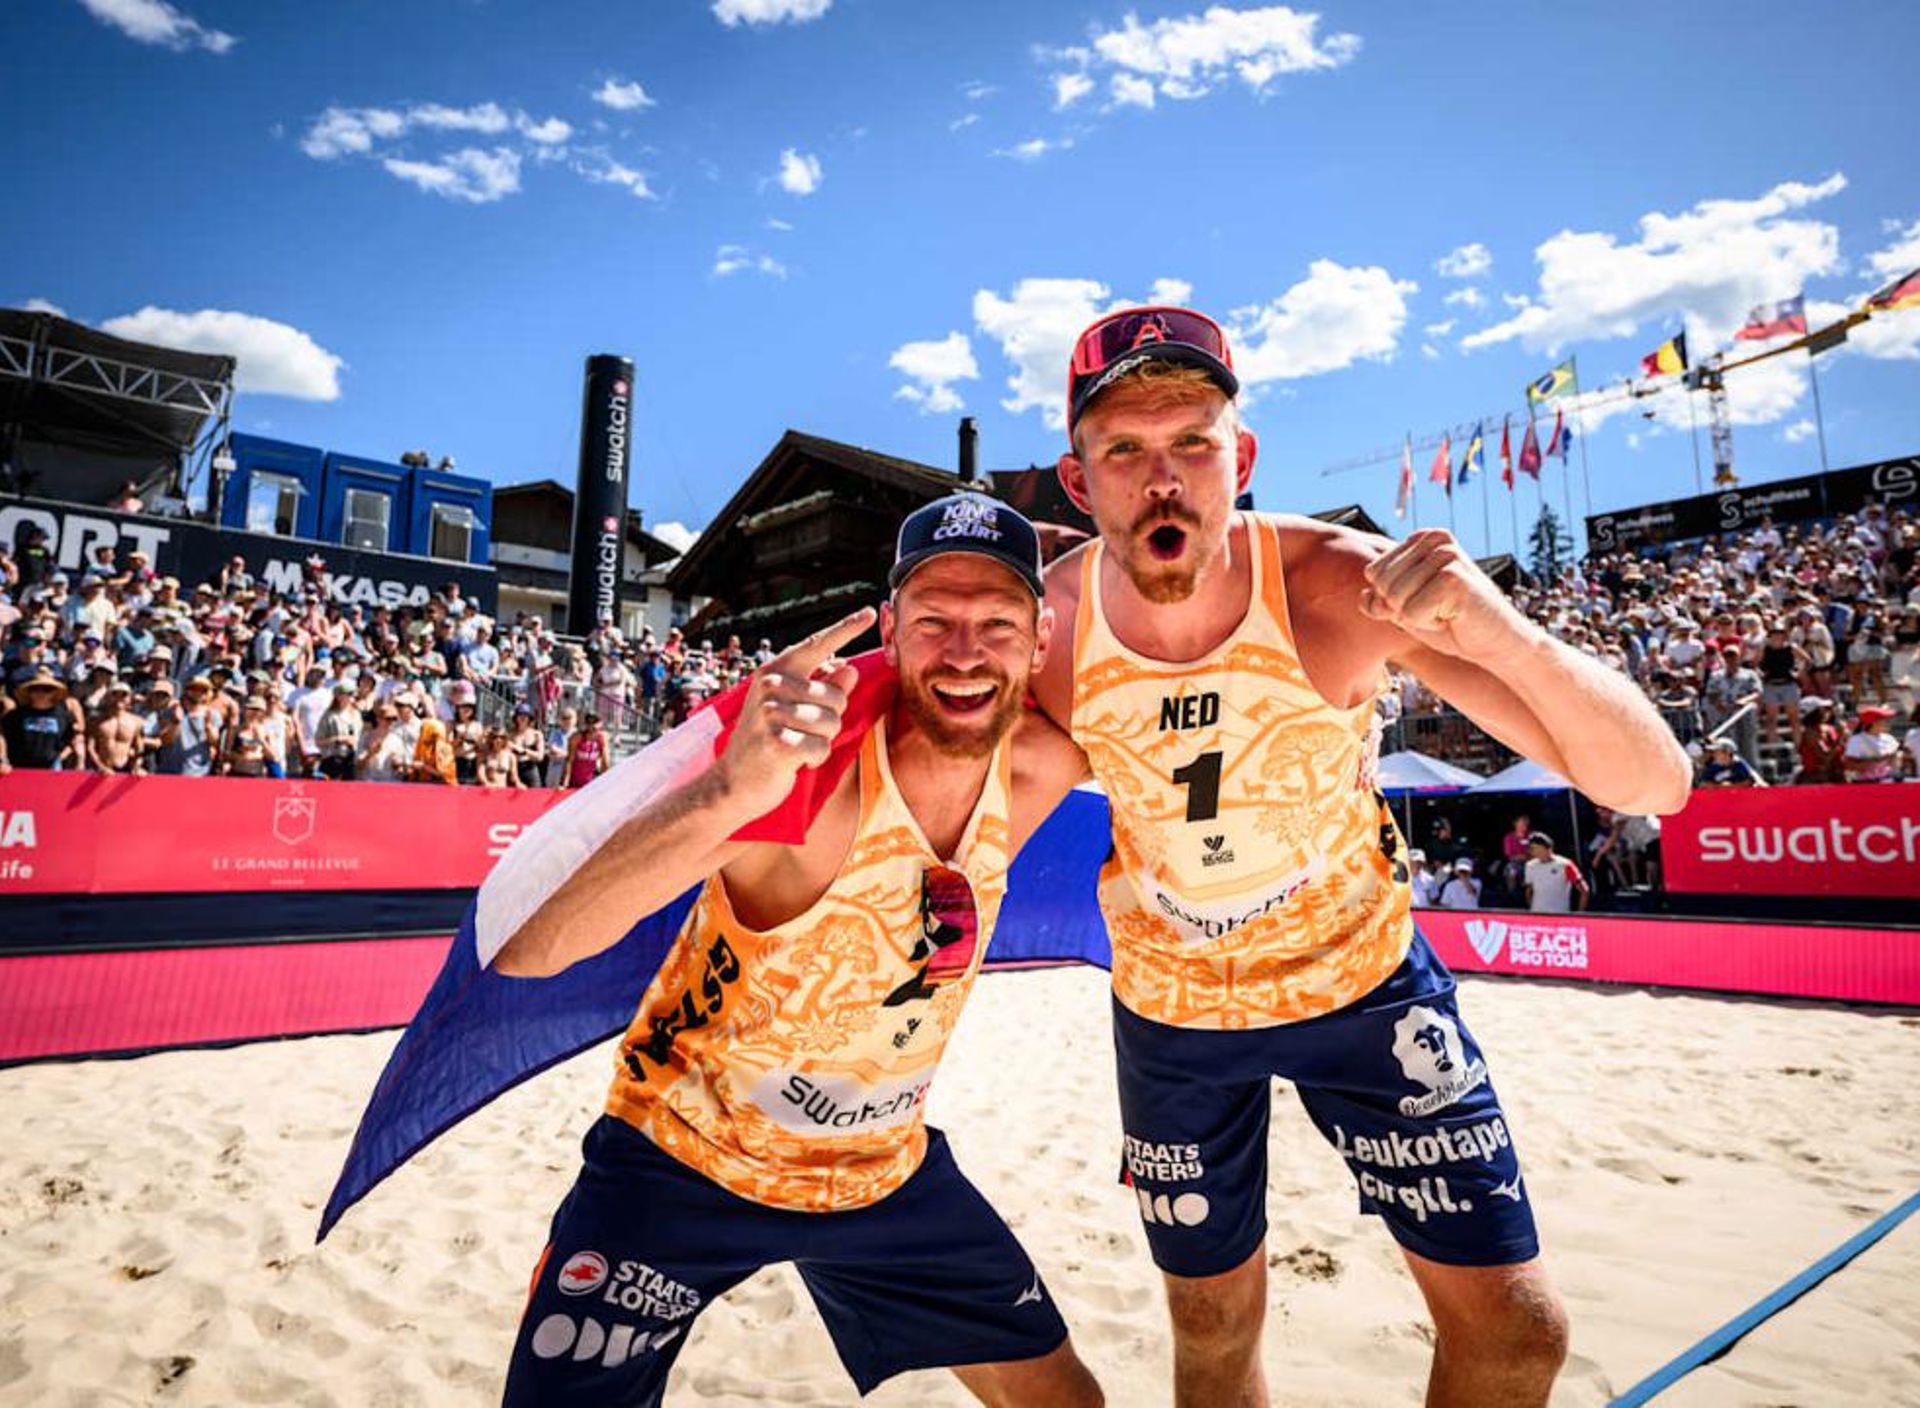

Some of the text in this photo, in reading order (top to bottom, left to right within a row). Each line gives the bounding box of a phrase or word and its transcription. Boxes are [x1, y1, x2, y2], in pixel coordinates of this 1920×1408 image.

[606, 395, 627, 483] swatch
[933, 522, 1004, 541] COURT
[943, 501, 998, 523] KING
[263, 557, 431, 605] MKASA
[596, 532, 618, 626] swatch
[1159, 692, 1220, 731] NED
[1172, 751, 1223, 823] 1
[234, 857, 290, 871] GRAND
[293, 856, 361, 871] BELLEVUE
[1509, 931, 1586, 953] BEACH
[1510, 950, 1588, 969] PRO TOUR
[780, 1075, 914, 1127] swatch
[1333, 1117, 1508, 1168] Leukotape
[614, 1260, 700, 1308] STAATS
